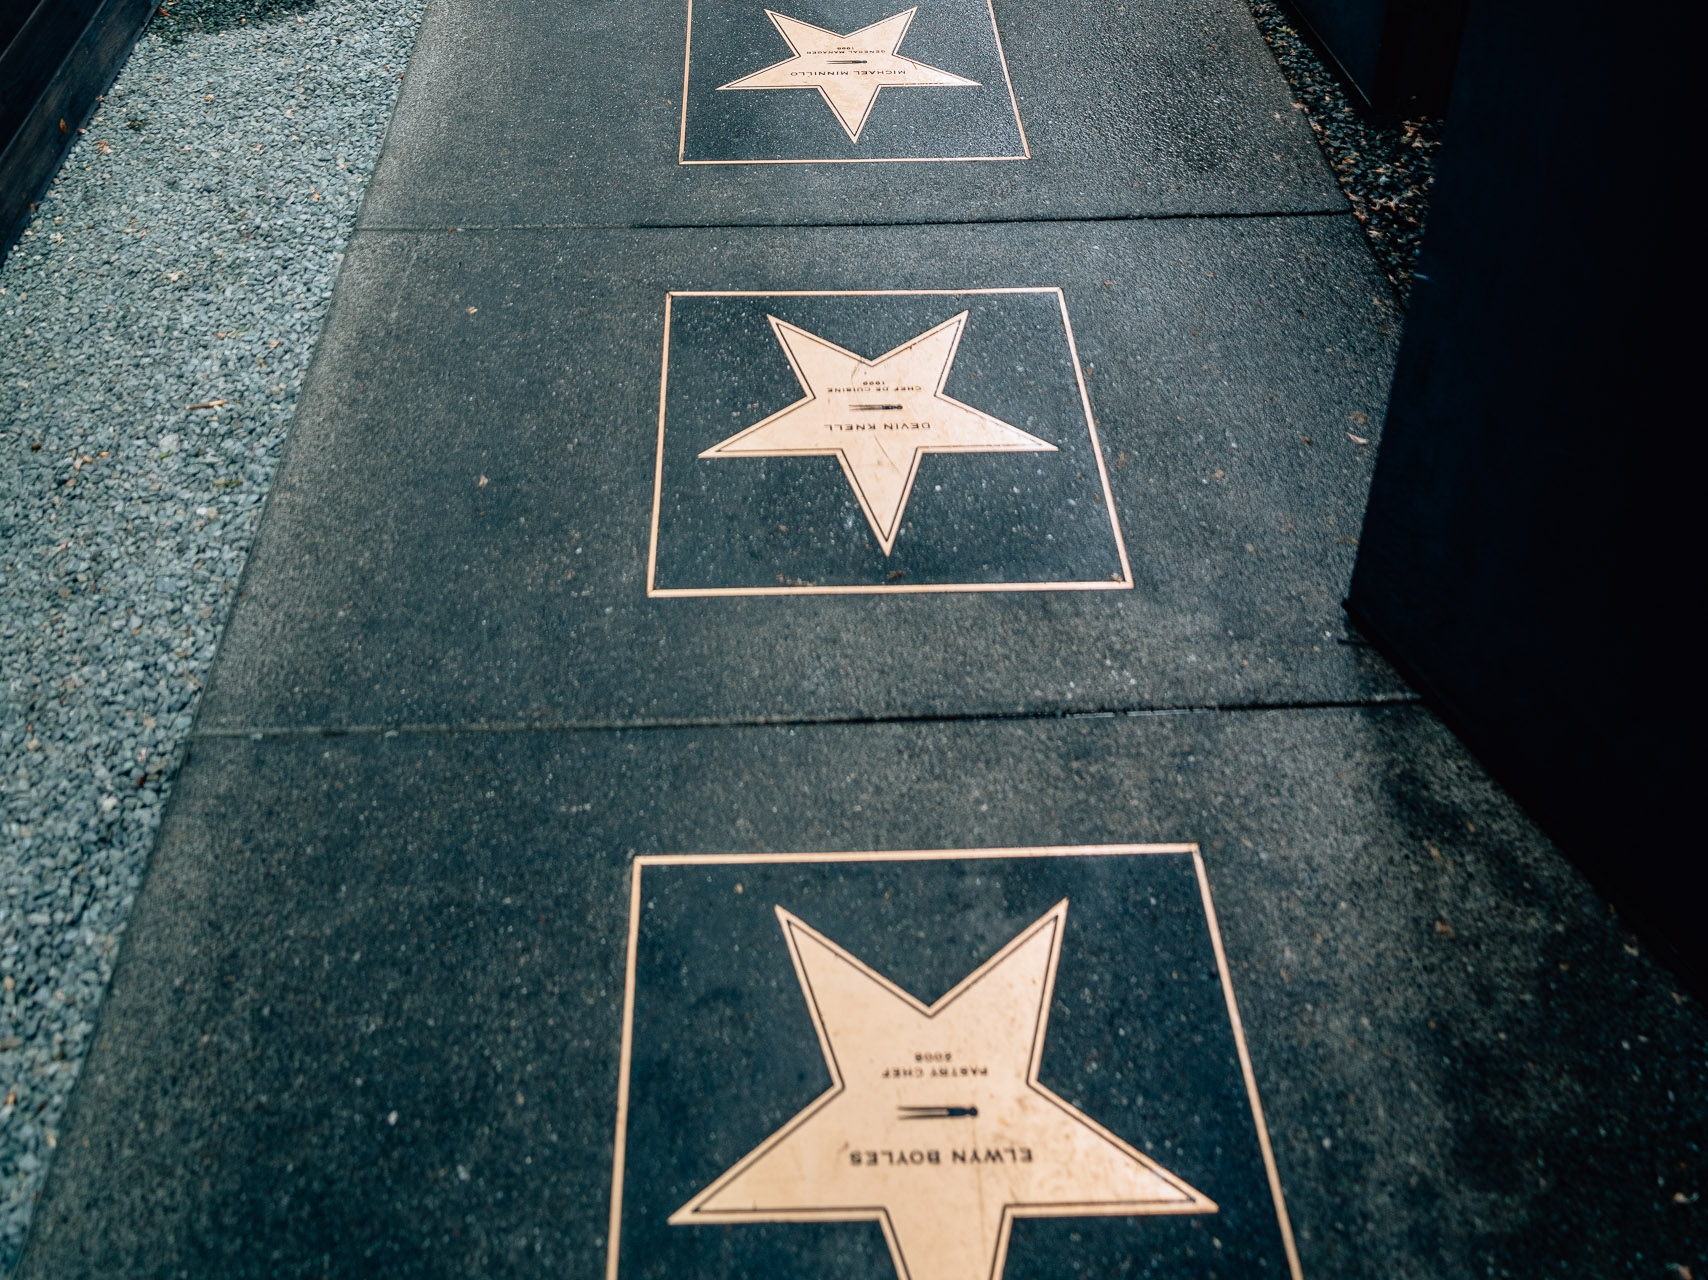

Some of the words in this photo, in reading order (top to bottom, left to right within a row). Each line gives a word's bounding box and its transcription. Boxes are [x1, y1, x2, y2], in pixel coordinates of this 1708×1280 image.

[823, 423, 876, 431] KNELL
[883, 422, 931, 430] DEVIN
[882, 1067, 924, 1079] CHEF
[930, 1066, 988, 1077] PASTRY
[849, 1148, 941, 1166] BOYLES
[951, 1147, 1033, 1164] ELWYN
